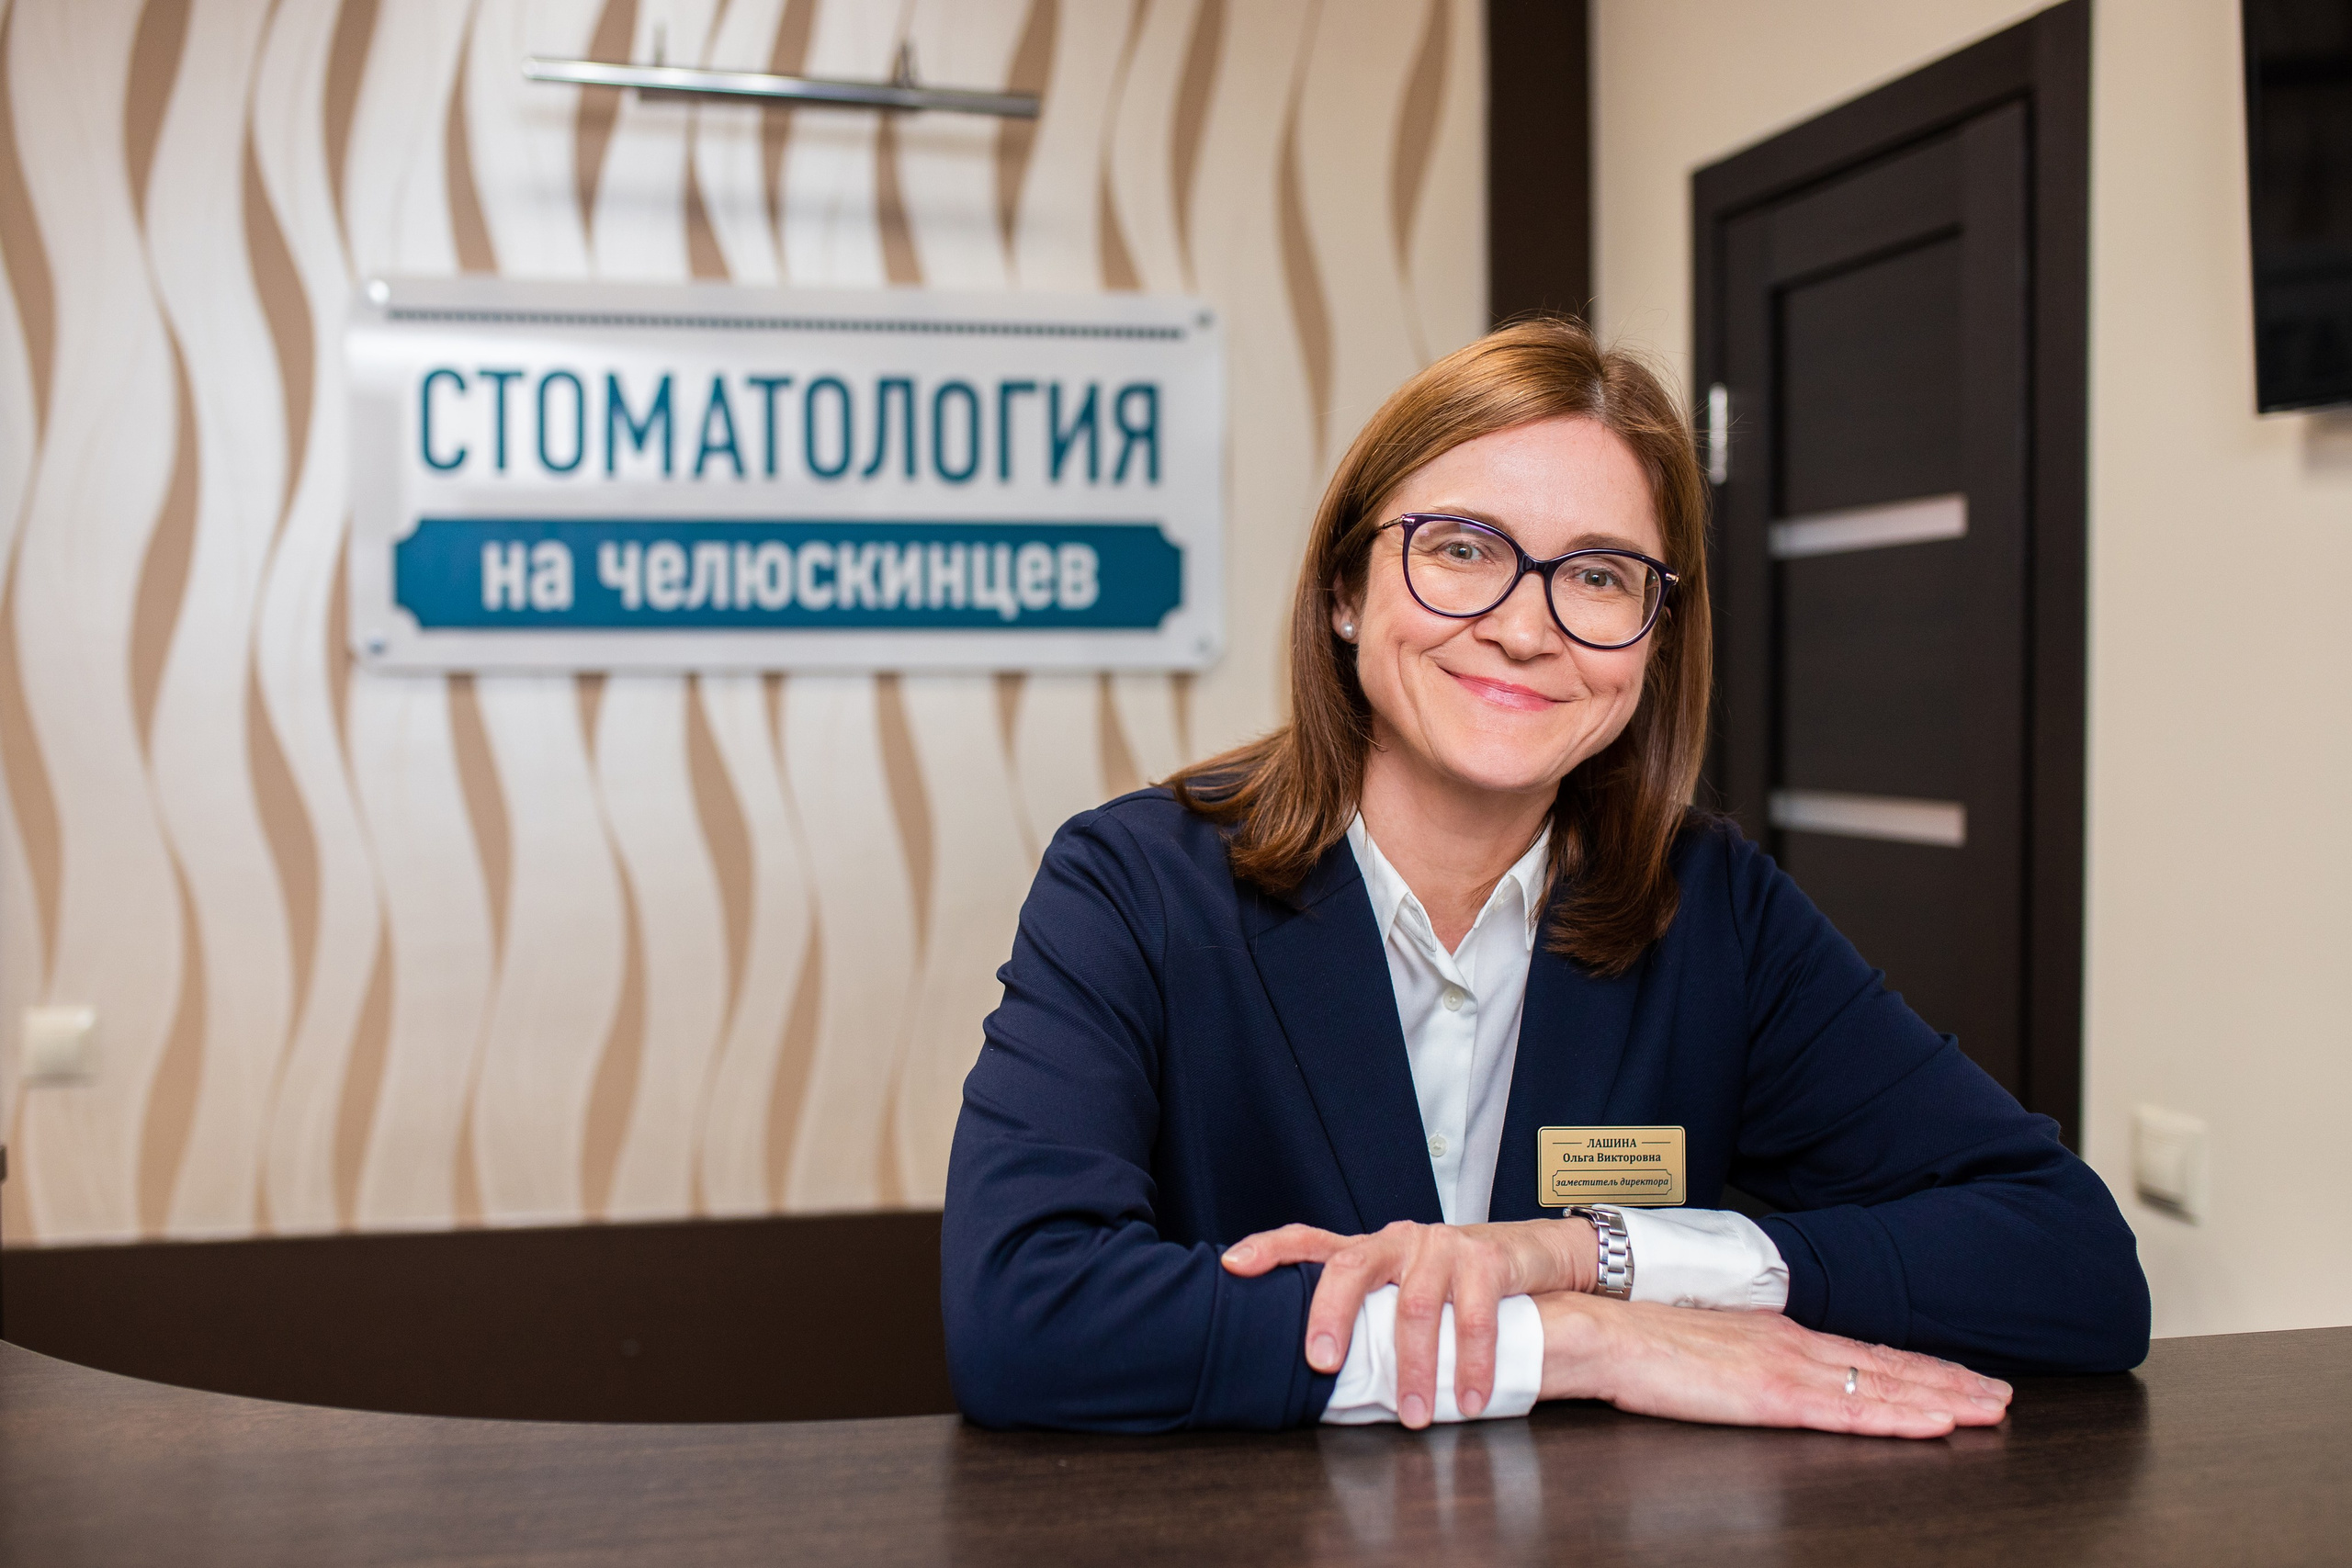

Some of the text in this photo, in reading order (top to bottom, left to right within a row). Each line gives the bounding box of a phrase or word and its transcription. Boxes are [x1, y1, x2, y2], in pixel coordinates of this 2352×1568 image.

[417, 366, 1163, 487] СТОМАТОЛОГИЯ
[479, 540, 1100, 621] на челюскинцев
[1587, 1138, 1637, 1147] ЛАШИНА
[1563, 1152, 1661, 1164] Ольга Викторовна
[1555, 1178, 1668, 1188] заместитель директора
